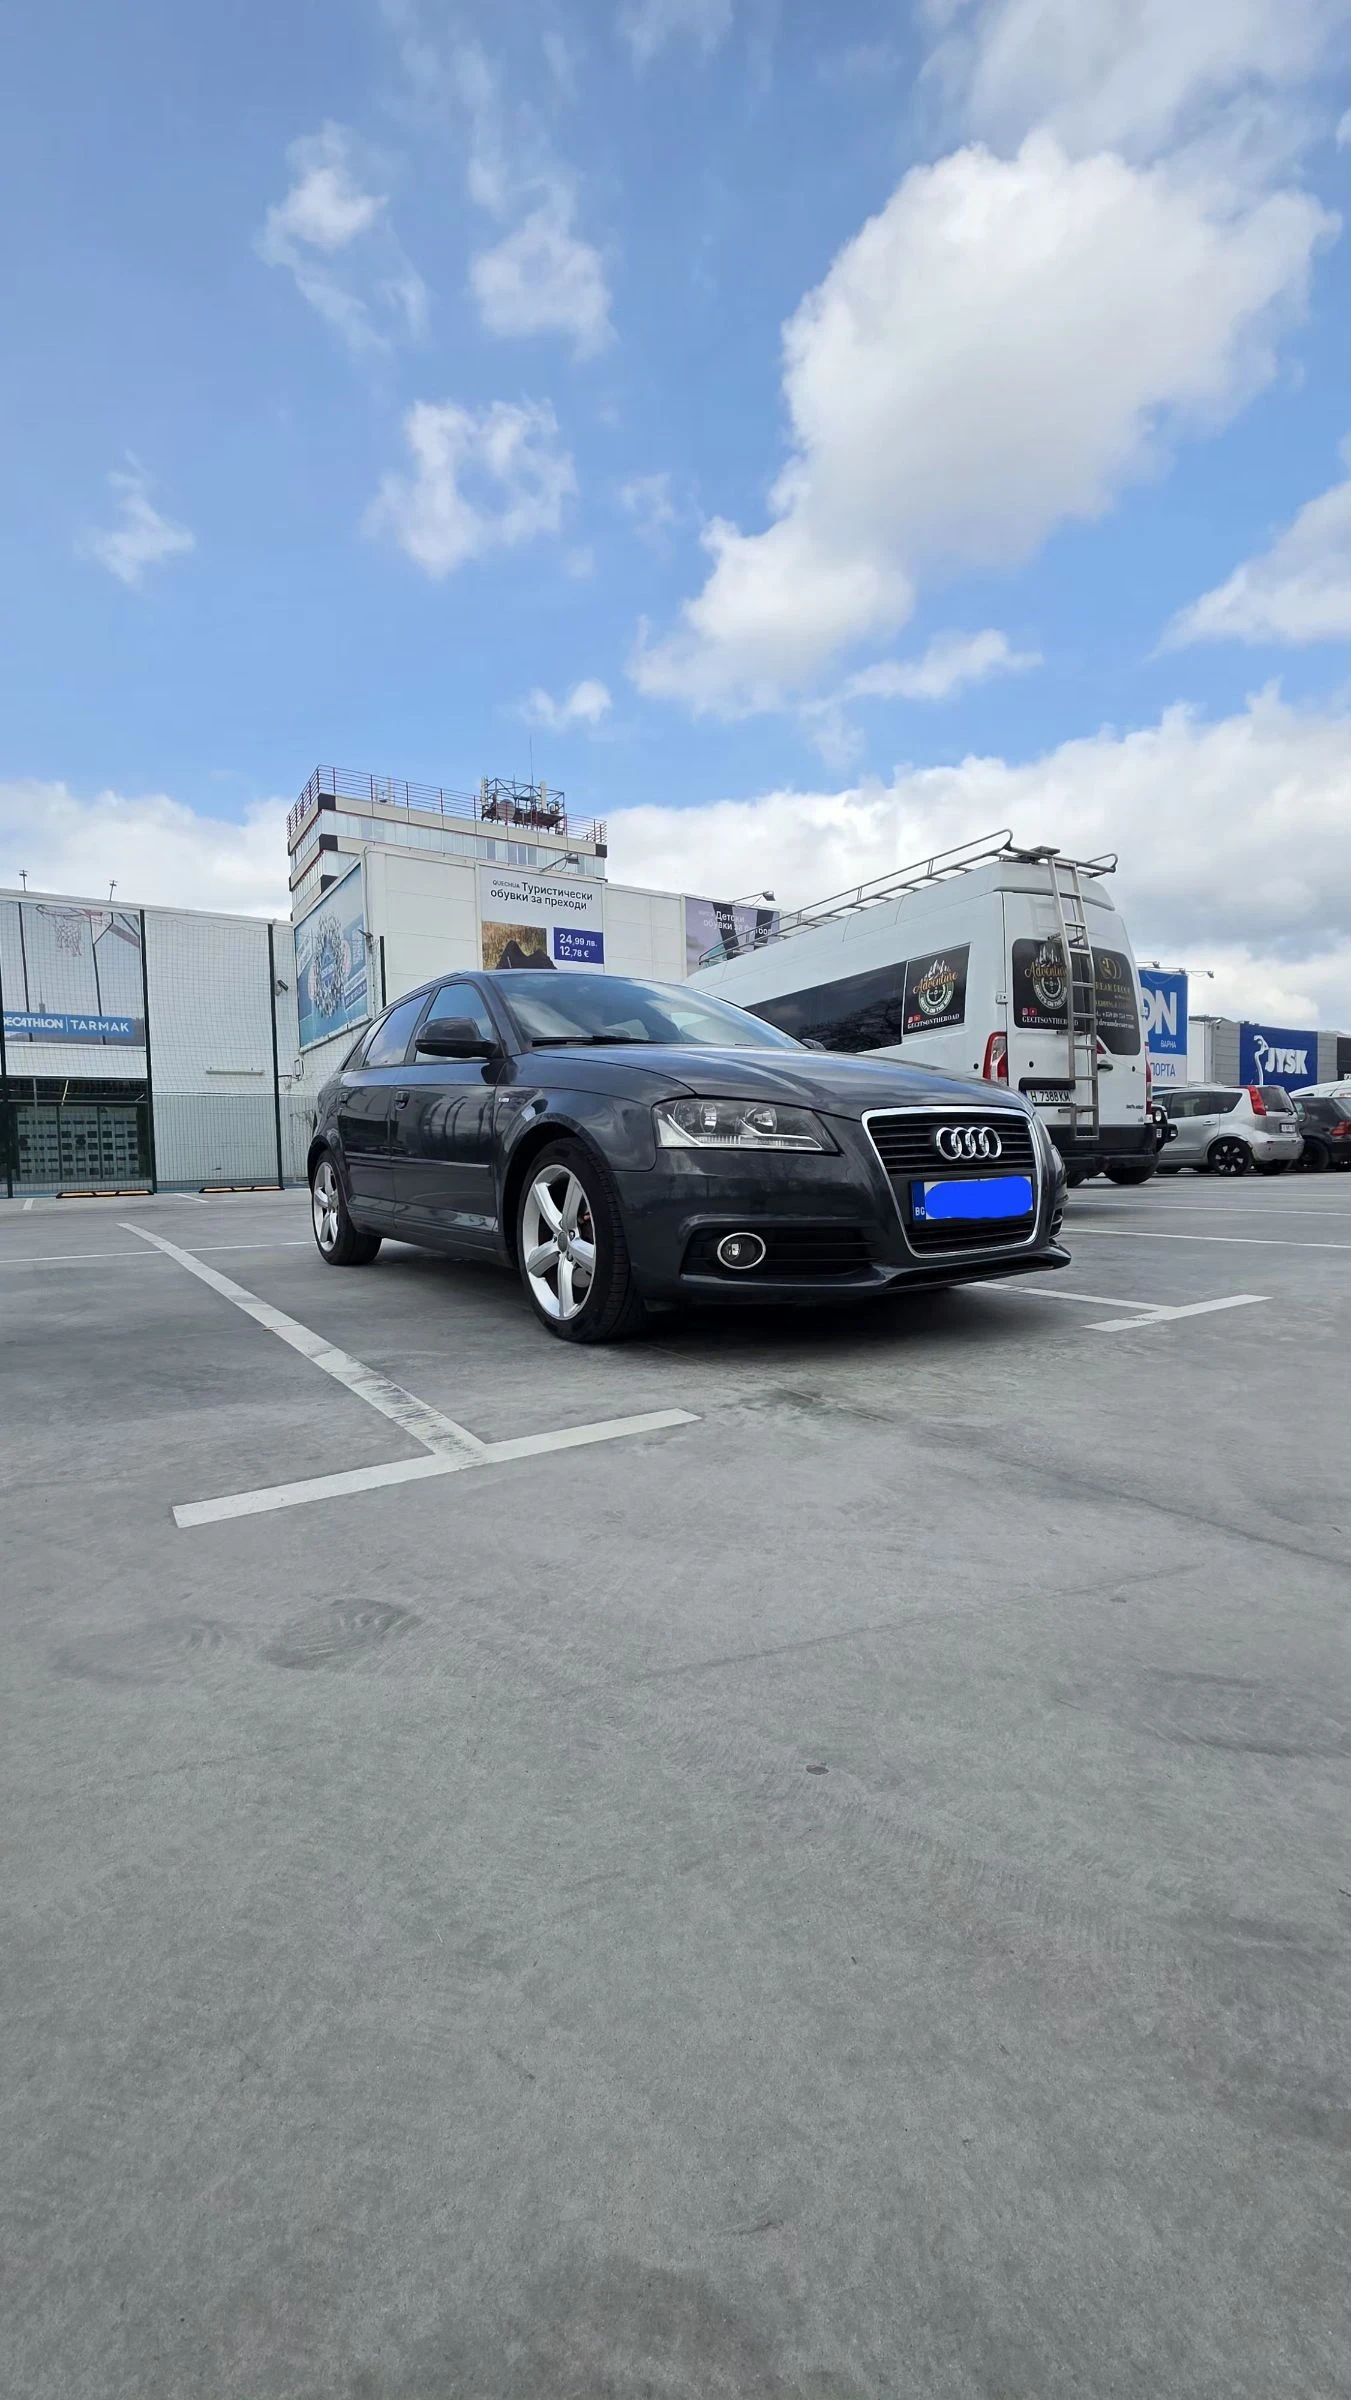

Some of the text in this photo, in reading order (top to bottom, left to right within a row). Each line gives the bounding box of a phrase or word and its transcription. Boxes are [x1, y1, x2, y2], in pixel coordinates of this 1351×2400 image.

[521, 882, 593, 901] Туристически
[490, 889, 587, 910] обувки за преходи
[559, 933, 585, 945] 24,99
[559, 946, 590, 958] 12,78 €
[1024, 961, 1067, 980] Adventur
[70, 1019, 130, 1032] TARMAK
[1160, 1039, 1177, 1049] ВАРНА
[1265, 1047, 1309, 1075] JYSK
[1040, 1091, 1058, 1102] 7388
[915, 1206, 925, 1216] BG
